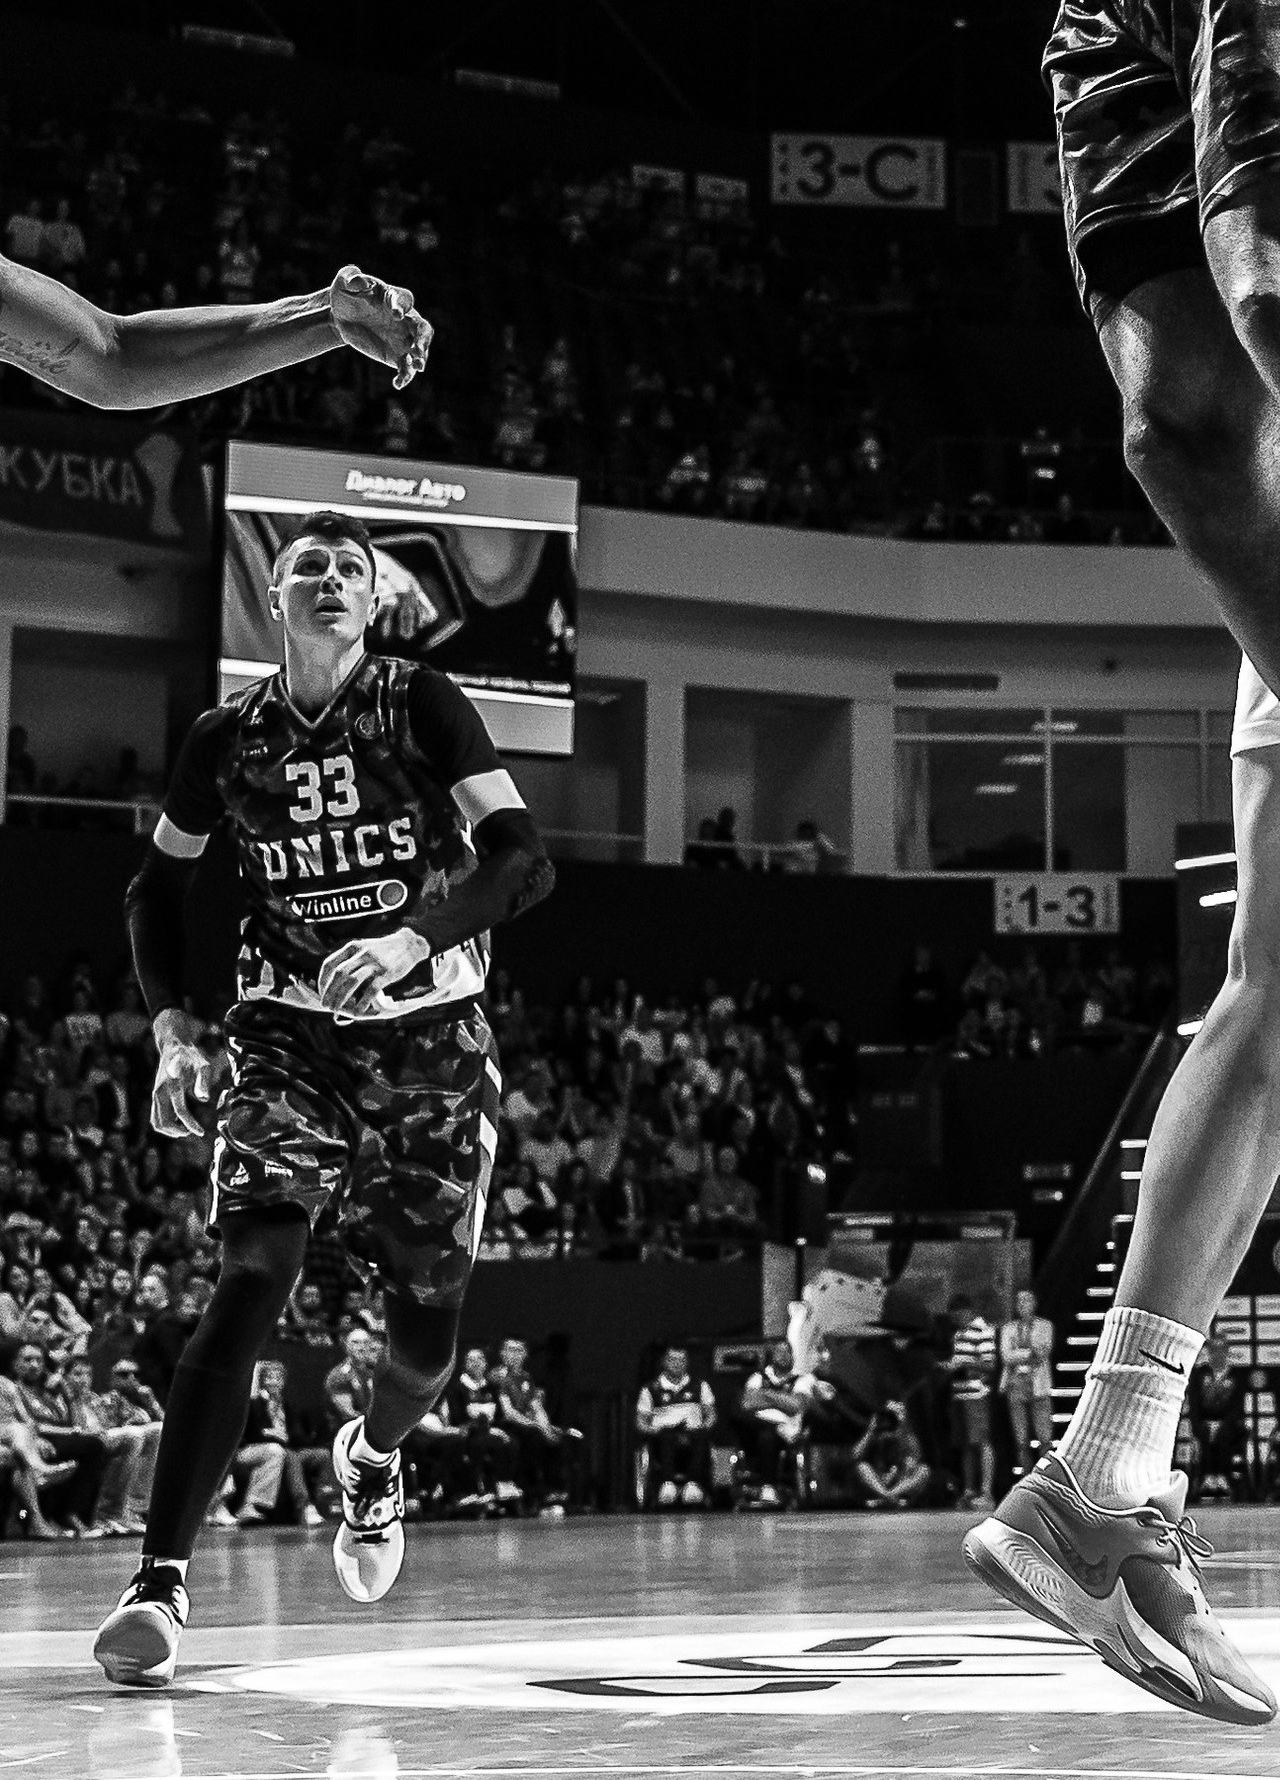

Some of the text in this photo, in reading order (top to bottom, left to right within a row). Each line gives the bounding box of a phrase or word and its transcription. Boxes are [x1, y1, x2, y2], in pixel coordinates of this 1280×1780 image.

[0, 446, 143, 506] КУБКА
[285, 754, 361, 823] 33
[257, 817, 417, 881] UNICS
[291, 895, 373, 917] Winline
[1019, 884, 1096, 928] 1-3
